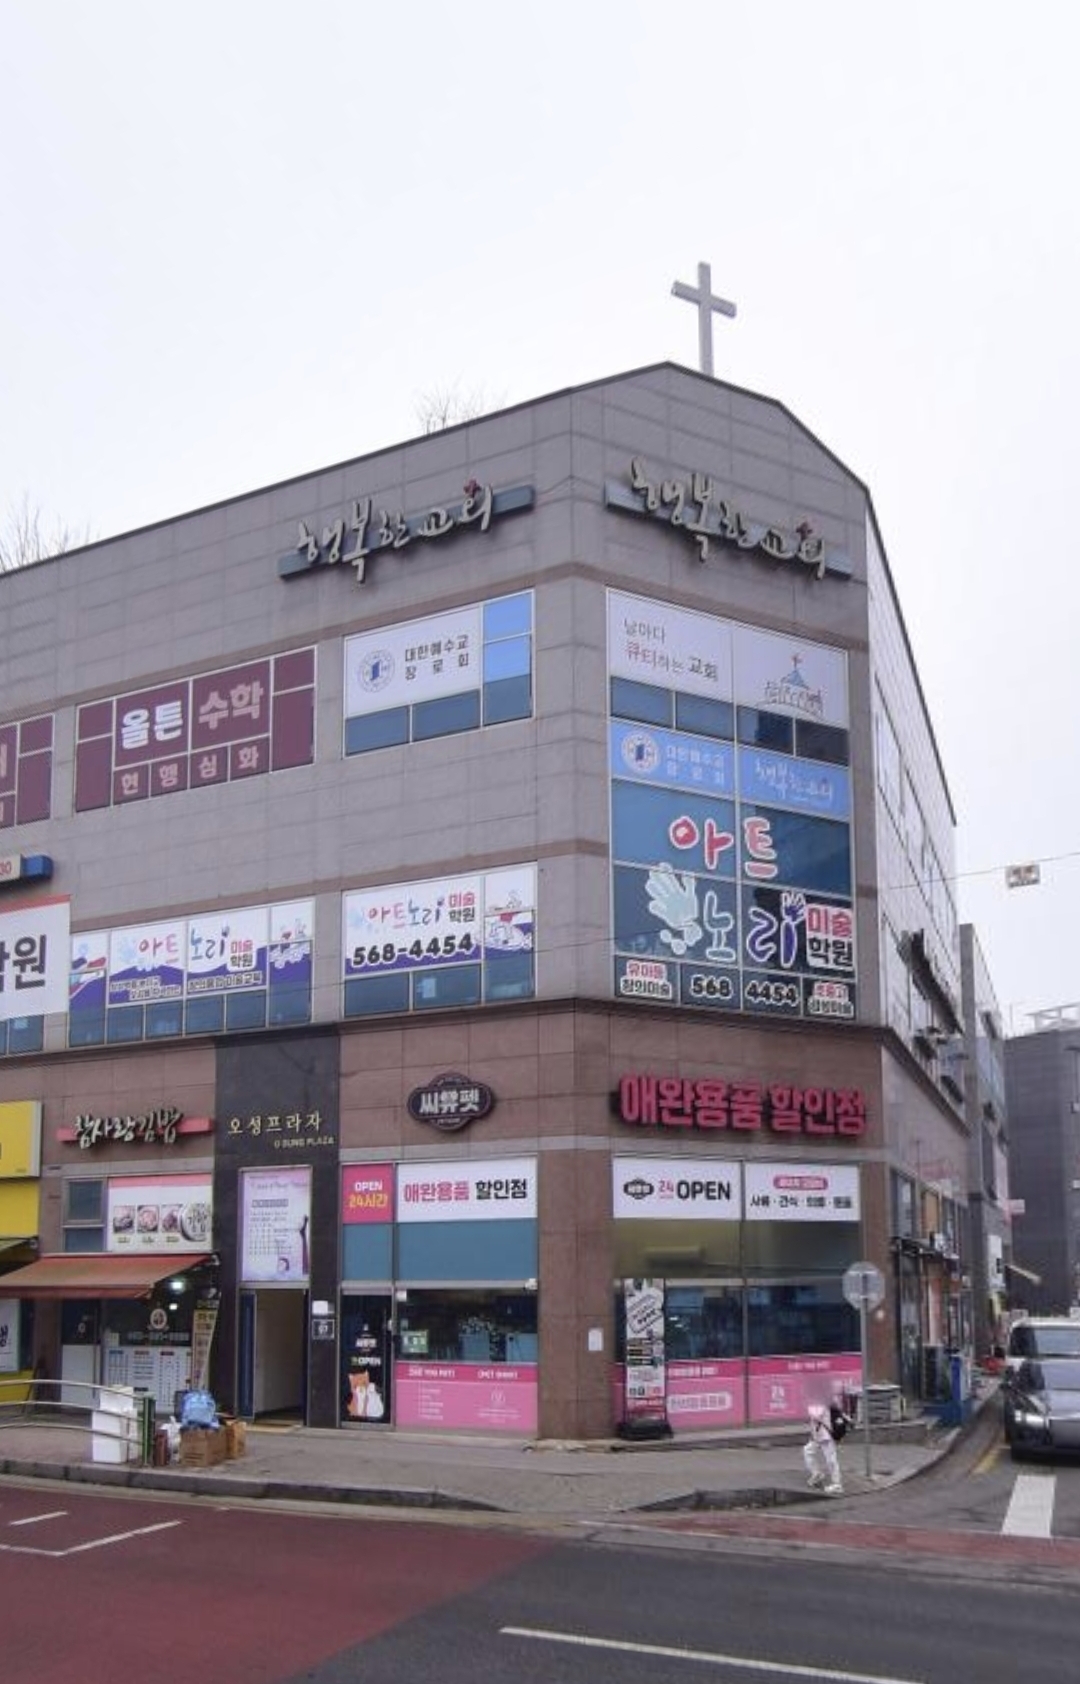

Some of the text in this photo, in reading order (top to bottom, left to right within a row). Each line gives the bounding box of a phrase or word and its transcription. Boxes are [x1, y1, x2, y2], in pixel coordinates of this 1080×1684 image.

[404, 634, 469, 662] 대한예수교
[405, 652, 469, 681] 장로회
[625, 641, 719, 682] 큐티하는 교회
[120, 681, 264, 750] 올튼 수학
[668, 815, 778, 879] 아트
[449, 892, 475, 908] 미술
[448, 908, 475, 923] 학원
[807, 906, 853, 938] 미술
[704, 890, 806, 969] 노리
[230, 940, 253, 954] 미술
[230, 952, 253, 968] 학원
[352, 932, 474, 966] 568-4454
[809, 937, 853, 967] 학원
[691, 975, 732, 997] 568
[746, 981, 799, 1004] 4454
[619, 1076, 867, 1135] 애완용품 할인점
[74, 1107, 183, 1149] 참사랑김밥
[227, 1110, 323, 1136] 오성프라자
[306, 1136, 335, 1146] PLAZA
[354, 1181, 384, 1191] OPEN
[404, 1178, 528, 1203] 애완용품 할인점
[658, 1180, 731, 1201] 24 OPEN
[348, 1193, 388, 1208] 24시간
